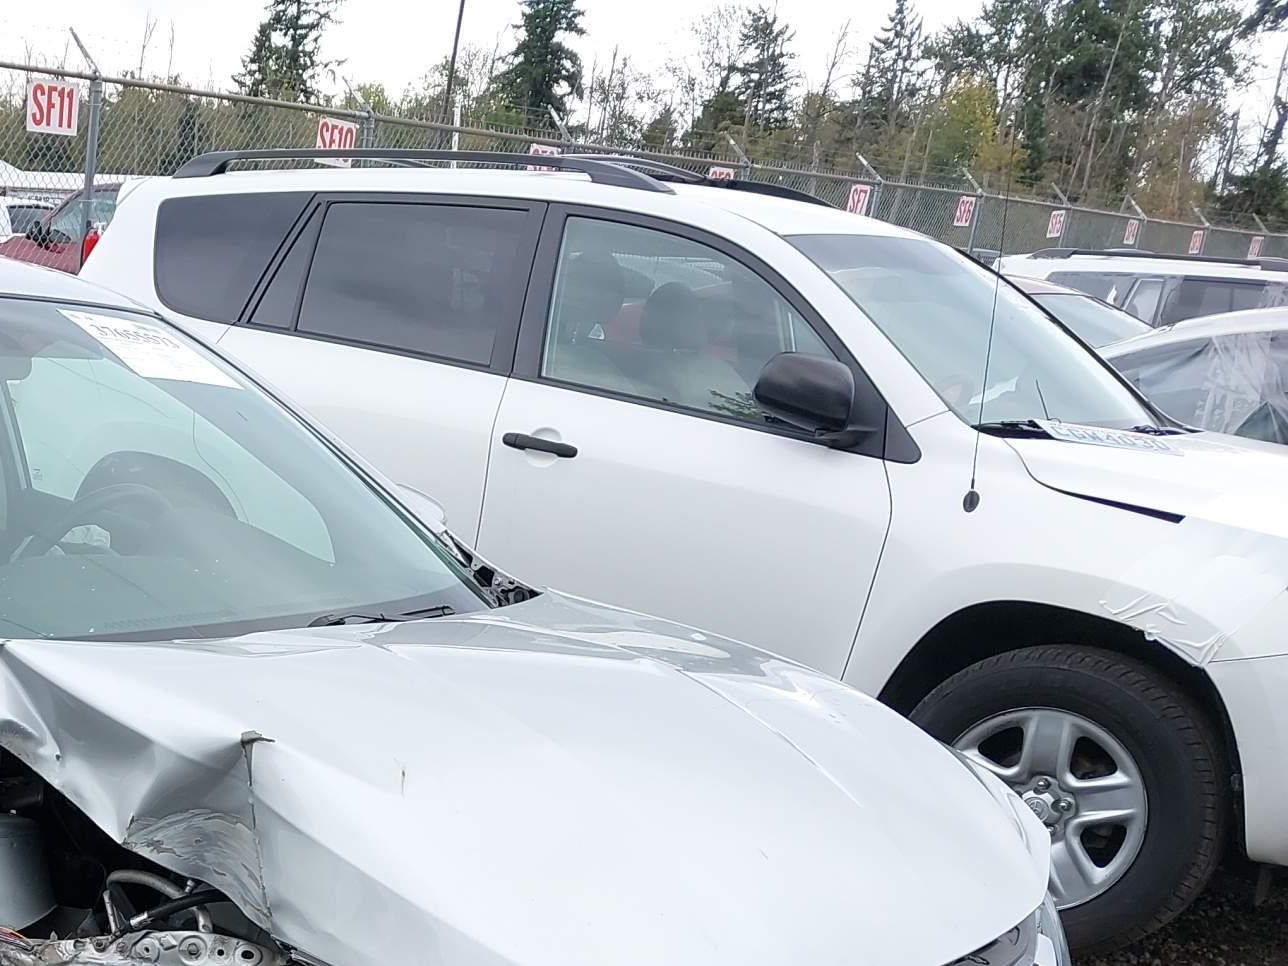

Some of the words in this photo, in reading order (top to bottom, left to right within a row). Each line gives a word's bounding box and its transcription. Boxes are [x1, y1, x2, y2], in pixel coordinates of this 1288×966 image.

[32, 83, 74, 129] SF11
[319, 121, 355, 149] SF10
[849, 186, 867, 216] SF7
[956, 199, 975, 225] SF6
[89, 323, 180, 350] 37655573
